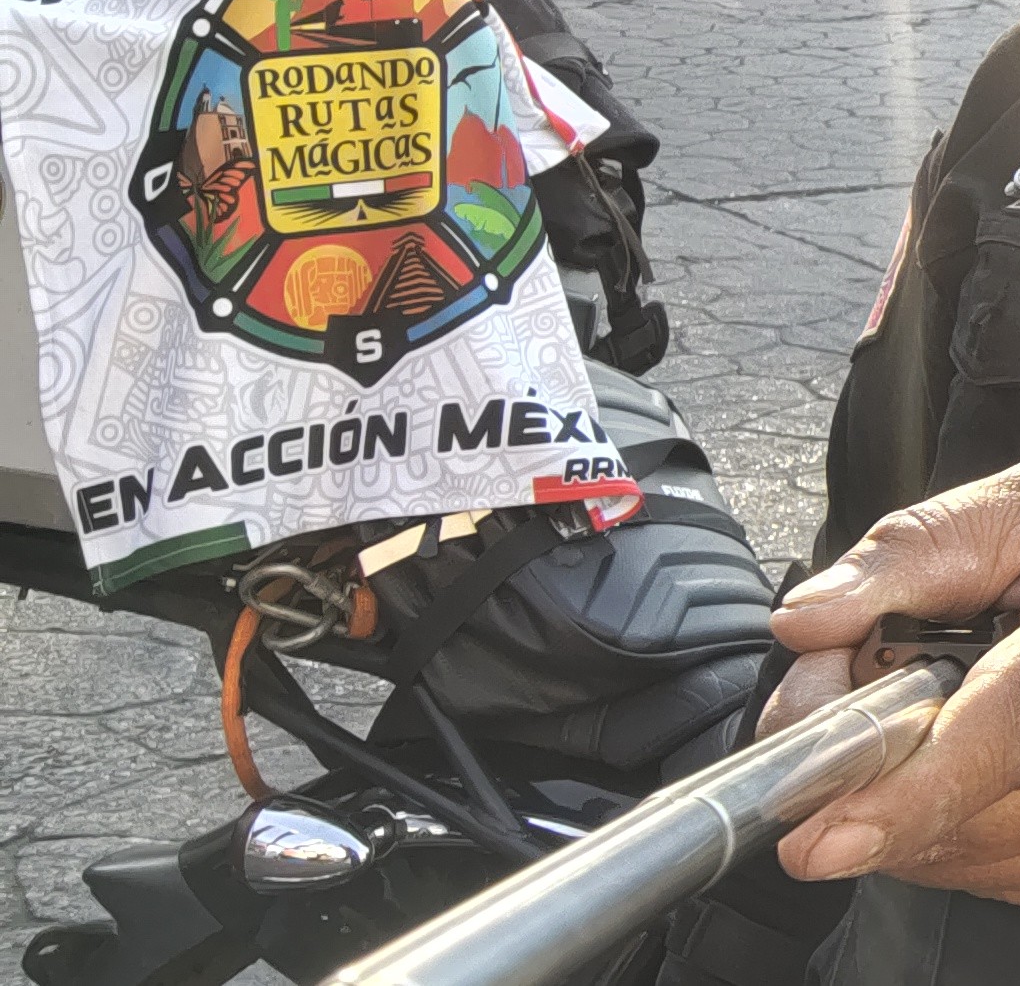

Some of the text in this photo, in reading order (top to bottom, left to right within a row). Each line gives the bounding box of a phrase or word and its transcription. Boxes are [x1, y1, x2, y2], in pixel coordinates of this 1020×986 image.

[354, 328, 383, 364] S
[76, 467, 155, 535] EN
[167, 399, 408, 503] ACCIÓN
